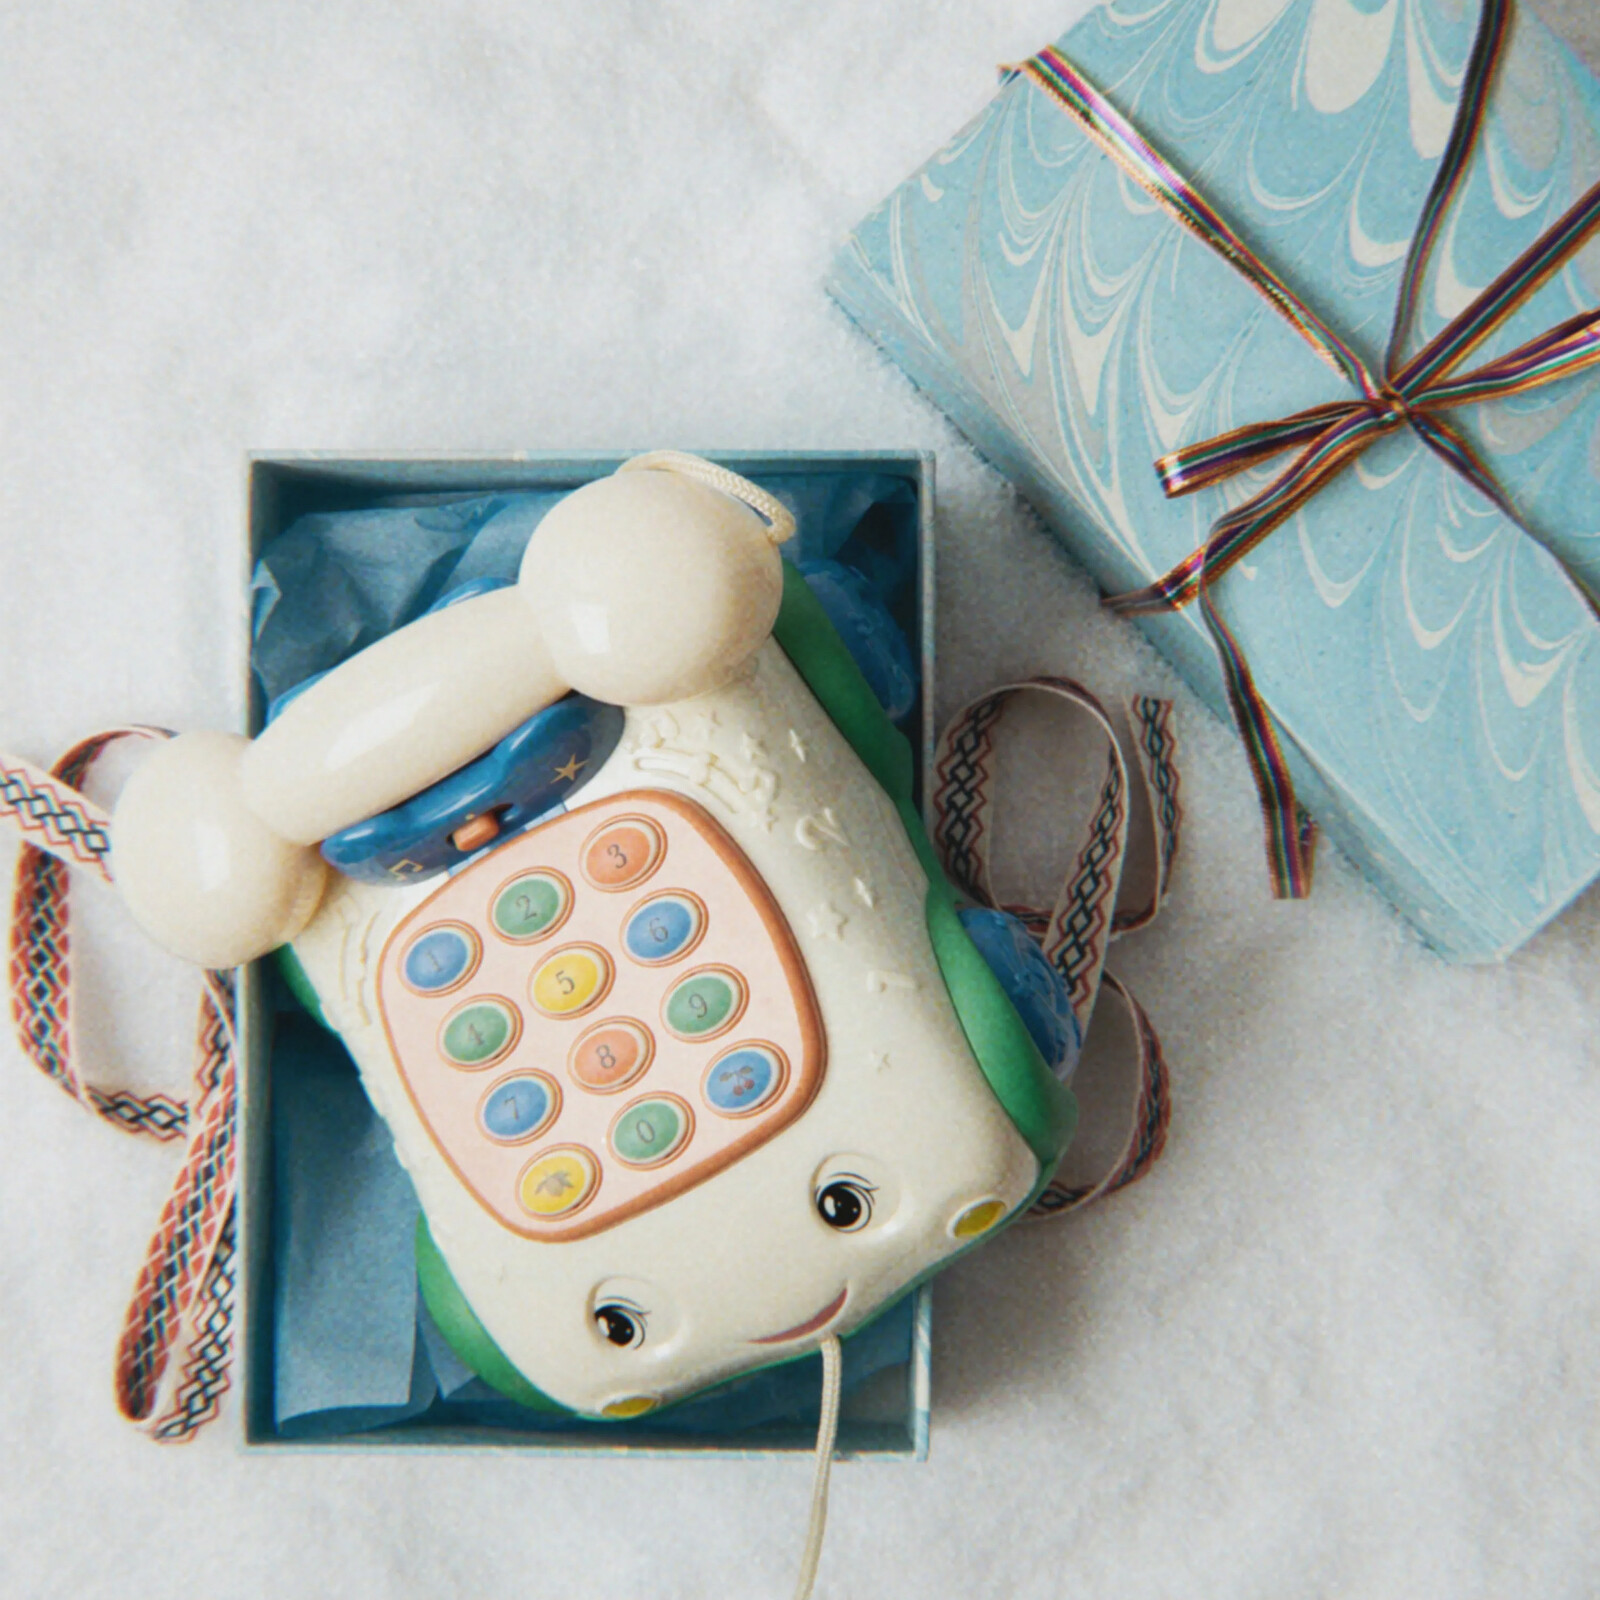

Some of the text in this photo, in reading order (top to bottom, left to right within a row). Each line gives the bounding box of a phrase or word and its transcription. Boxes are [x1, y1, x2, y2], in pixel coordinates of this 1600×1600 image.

[607, 844, 627, 869] 3
[515, 895, 538, 921] 2
[649, 917, 668, 943] 6
[425, 950, 442, 972] 1
[555, 970, 575, 995] 5
[688, 994, 707, 1019] 9
[467, 1023, 485, 1046] 4
[596, 1044, 616, 1069] 8
[503, 1096, 519, 1121] 7
[636, 1119, 655, 1143] 0
